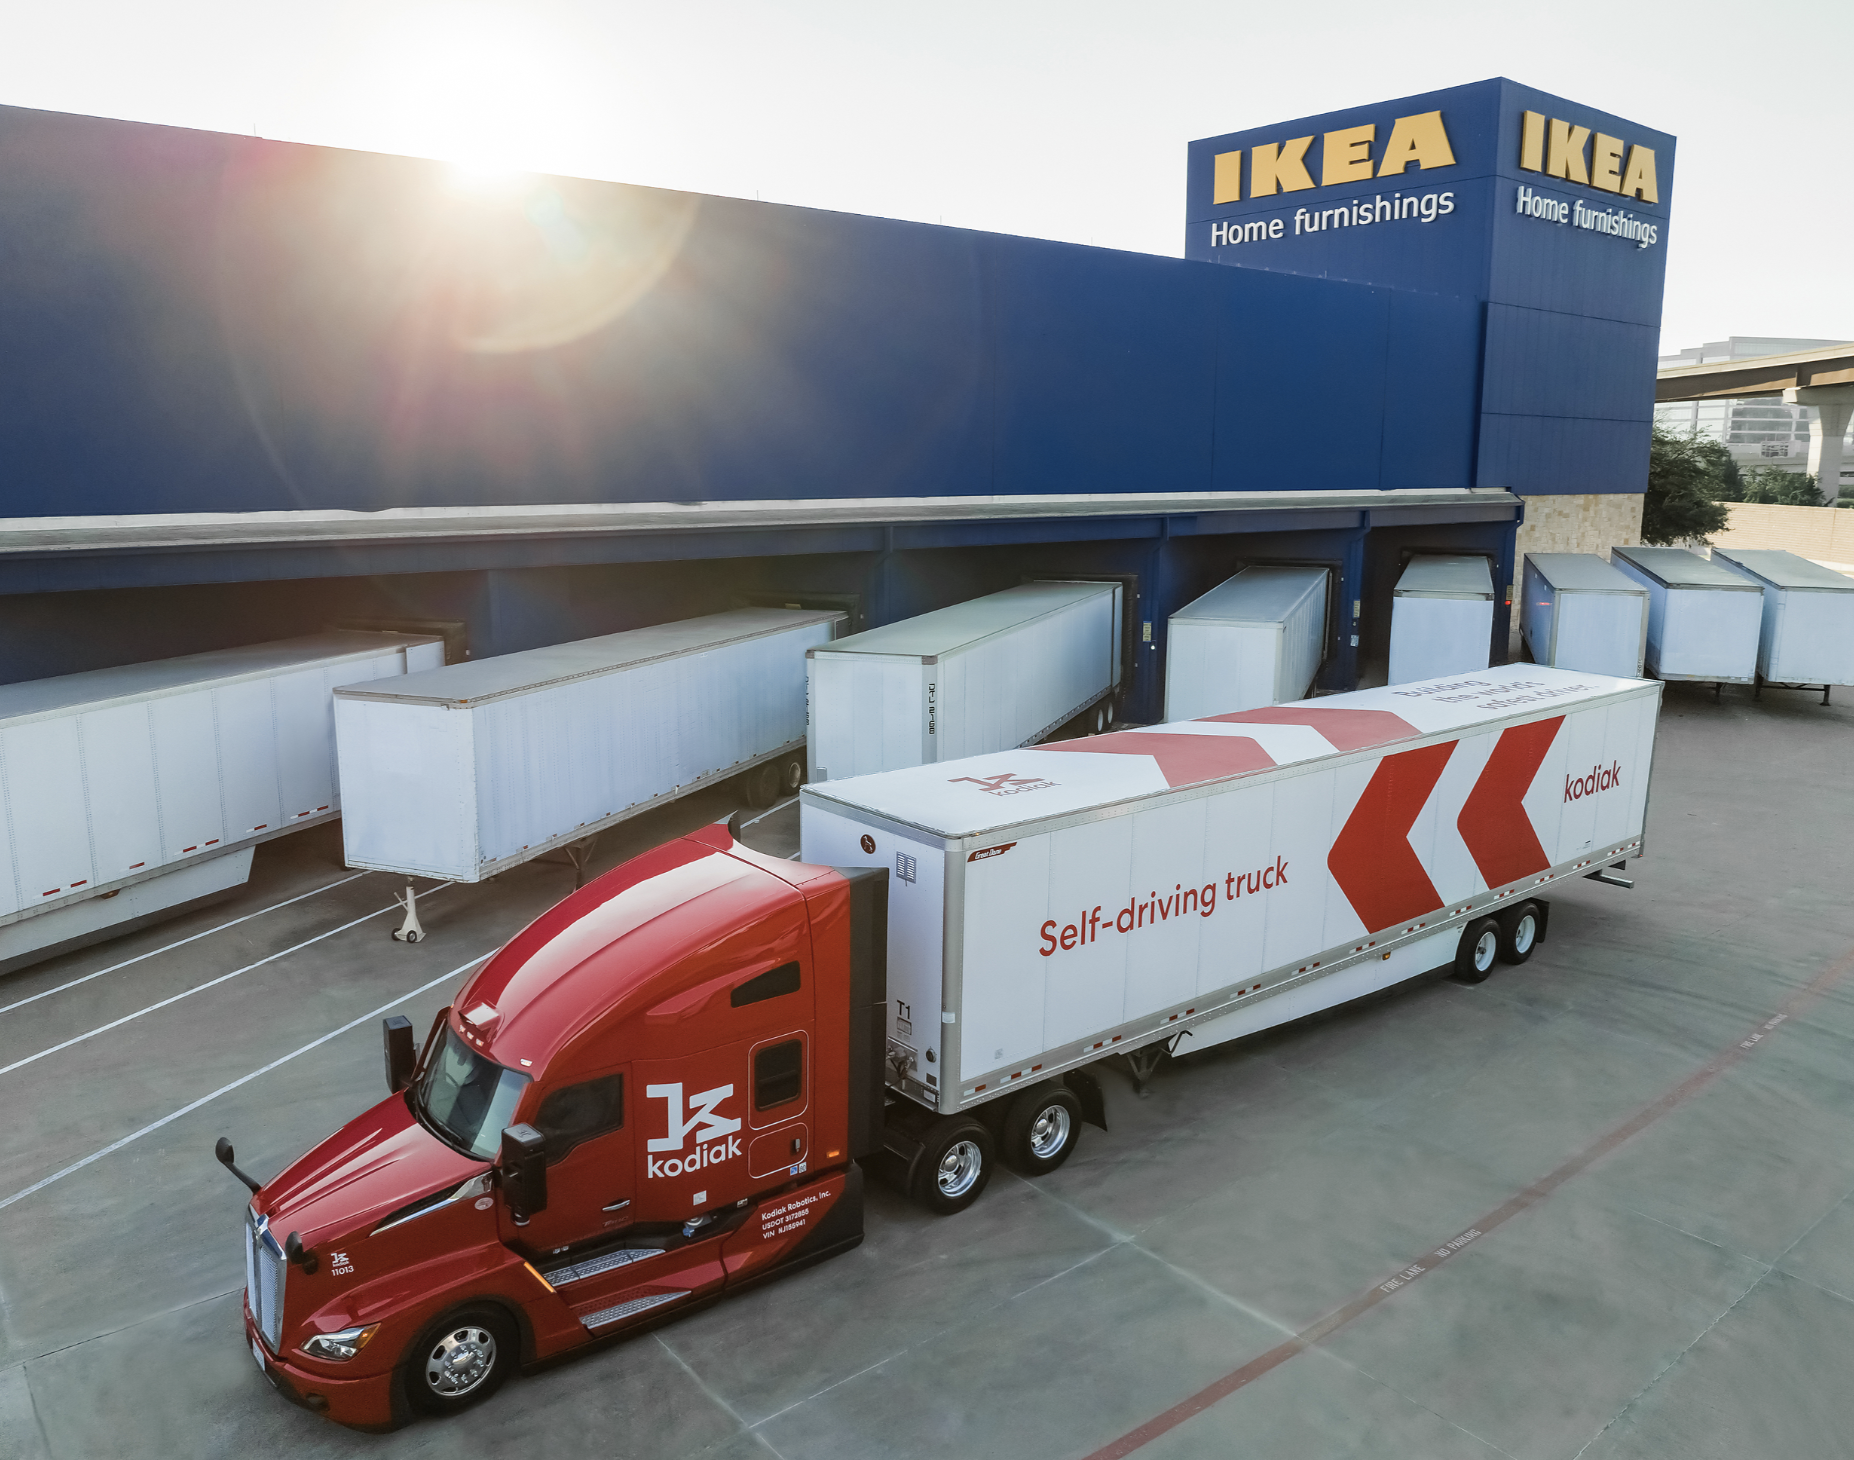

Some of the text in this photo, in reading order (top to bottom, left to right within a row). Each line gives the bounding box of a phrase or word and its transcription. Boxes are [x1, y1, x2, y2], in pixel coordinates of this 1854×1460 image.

[1213, 110, 1457, 205] IKEA
[1520, 110, 1659, 204] IKEA
[1211, 191, 1455, 248] Home furnishings
[1516, 186, 1658, 249] Home furnishings
[928, 683, 936, 703] DTL
[988, 781, 1062, 797] kodiak
[1563, 760, 1622, 804] kodiak
[1039, 855, 1289, 957] Self-driving truck
[897, 1000, 910, 1019] T1
[647, 1136, 743, 1179] kodiak
[761, 1206, 787, 1221] Kodiak
[818, 1190, 832, 1200] Inc.
[762, 1217, 785, 1231] USDOT
[763, 1230, 776, 1239] VIN
[331, 1265, 354, 1275] 11013
[1380, 1228, 1482, 1293] FIRE LANE NO PARKING
